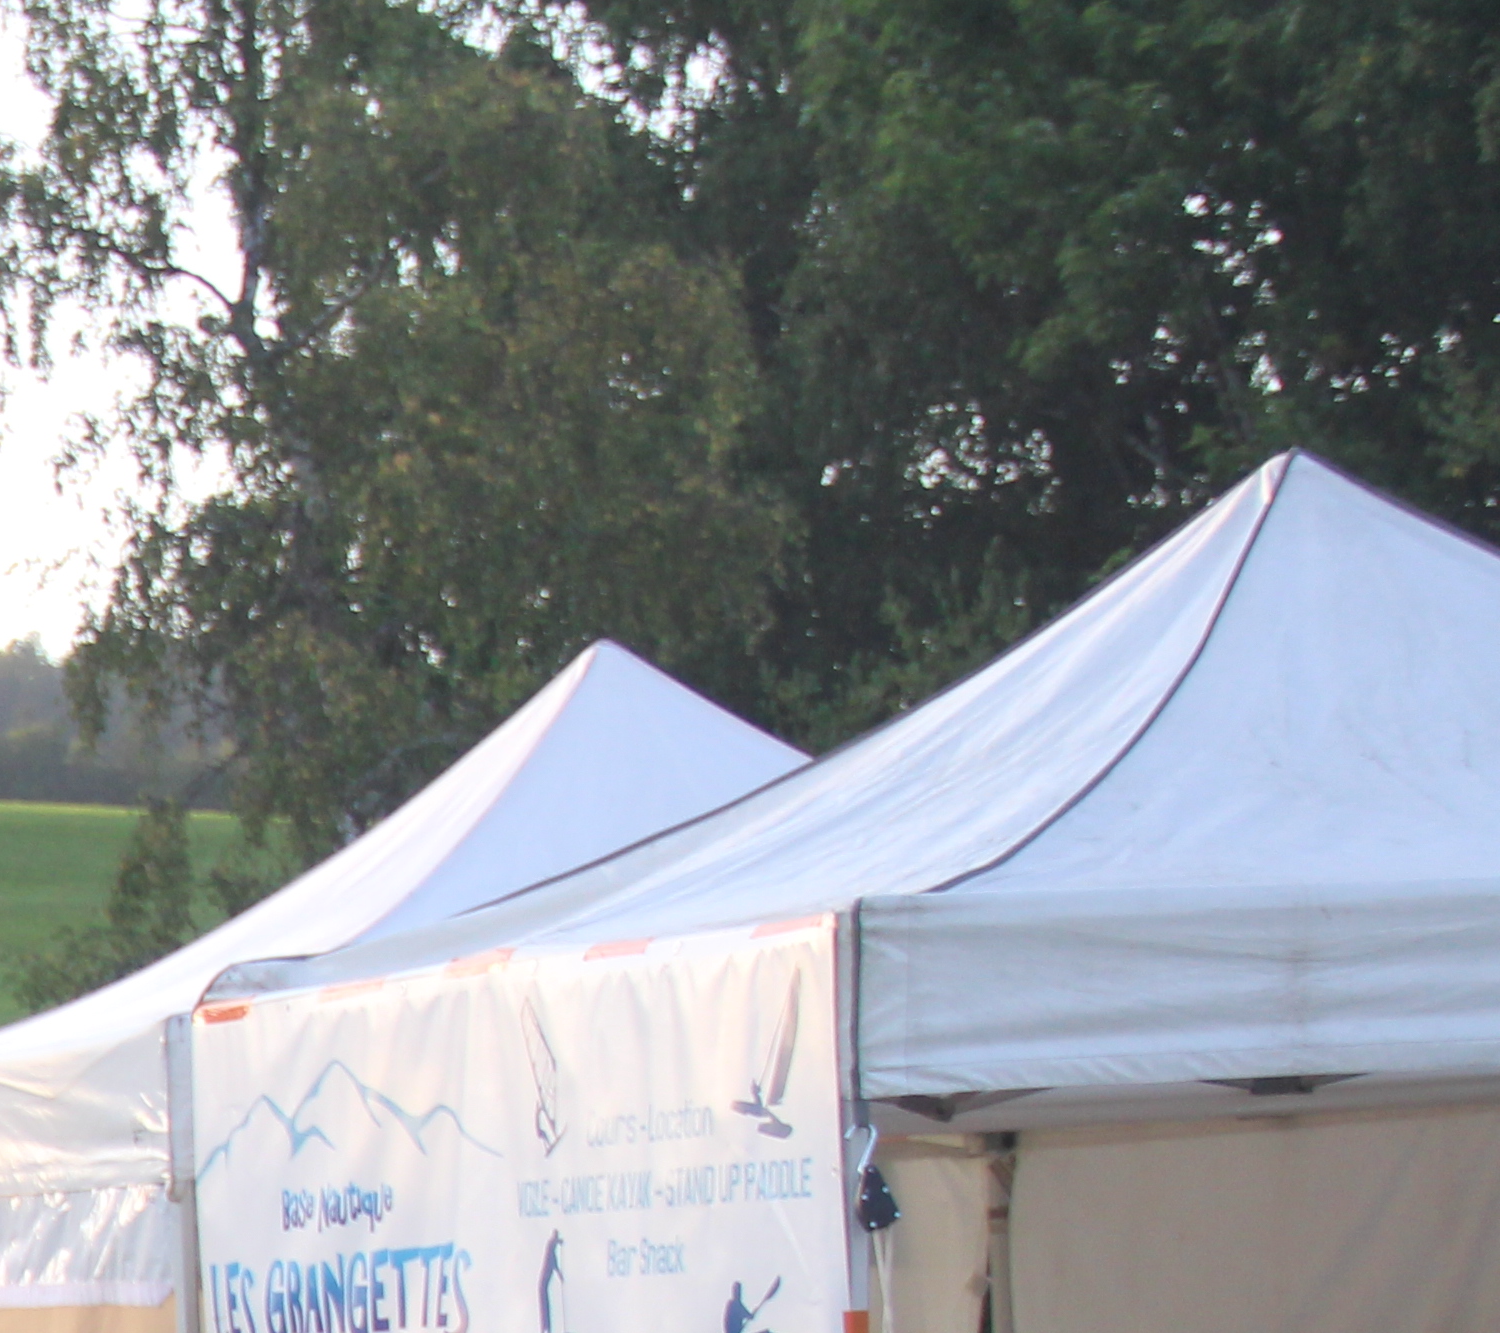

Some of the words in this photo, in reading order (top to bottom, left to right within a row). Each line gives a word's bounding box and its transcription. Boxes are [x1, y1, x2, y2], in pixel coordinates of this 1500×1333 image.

[649, 1099, 714, 1142] Location
[606, 1171, 653, 1211] KAYAK
[665, 1164, 716, 1208] STAND
[720, 1161, 740, 1203] UP
[744, 1156, 813, 1200] PADDLE
[281, 1187, 314, 1231] Base
[606, 1238, 637, 1277] Bar
[639, 1234, 687, 1276] Snack
